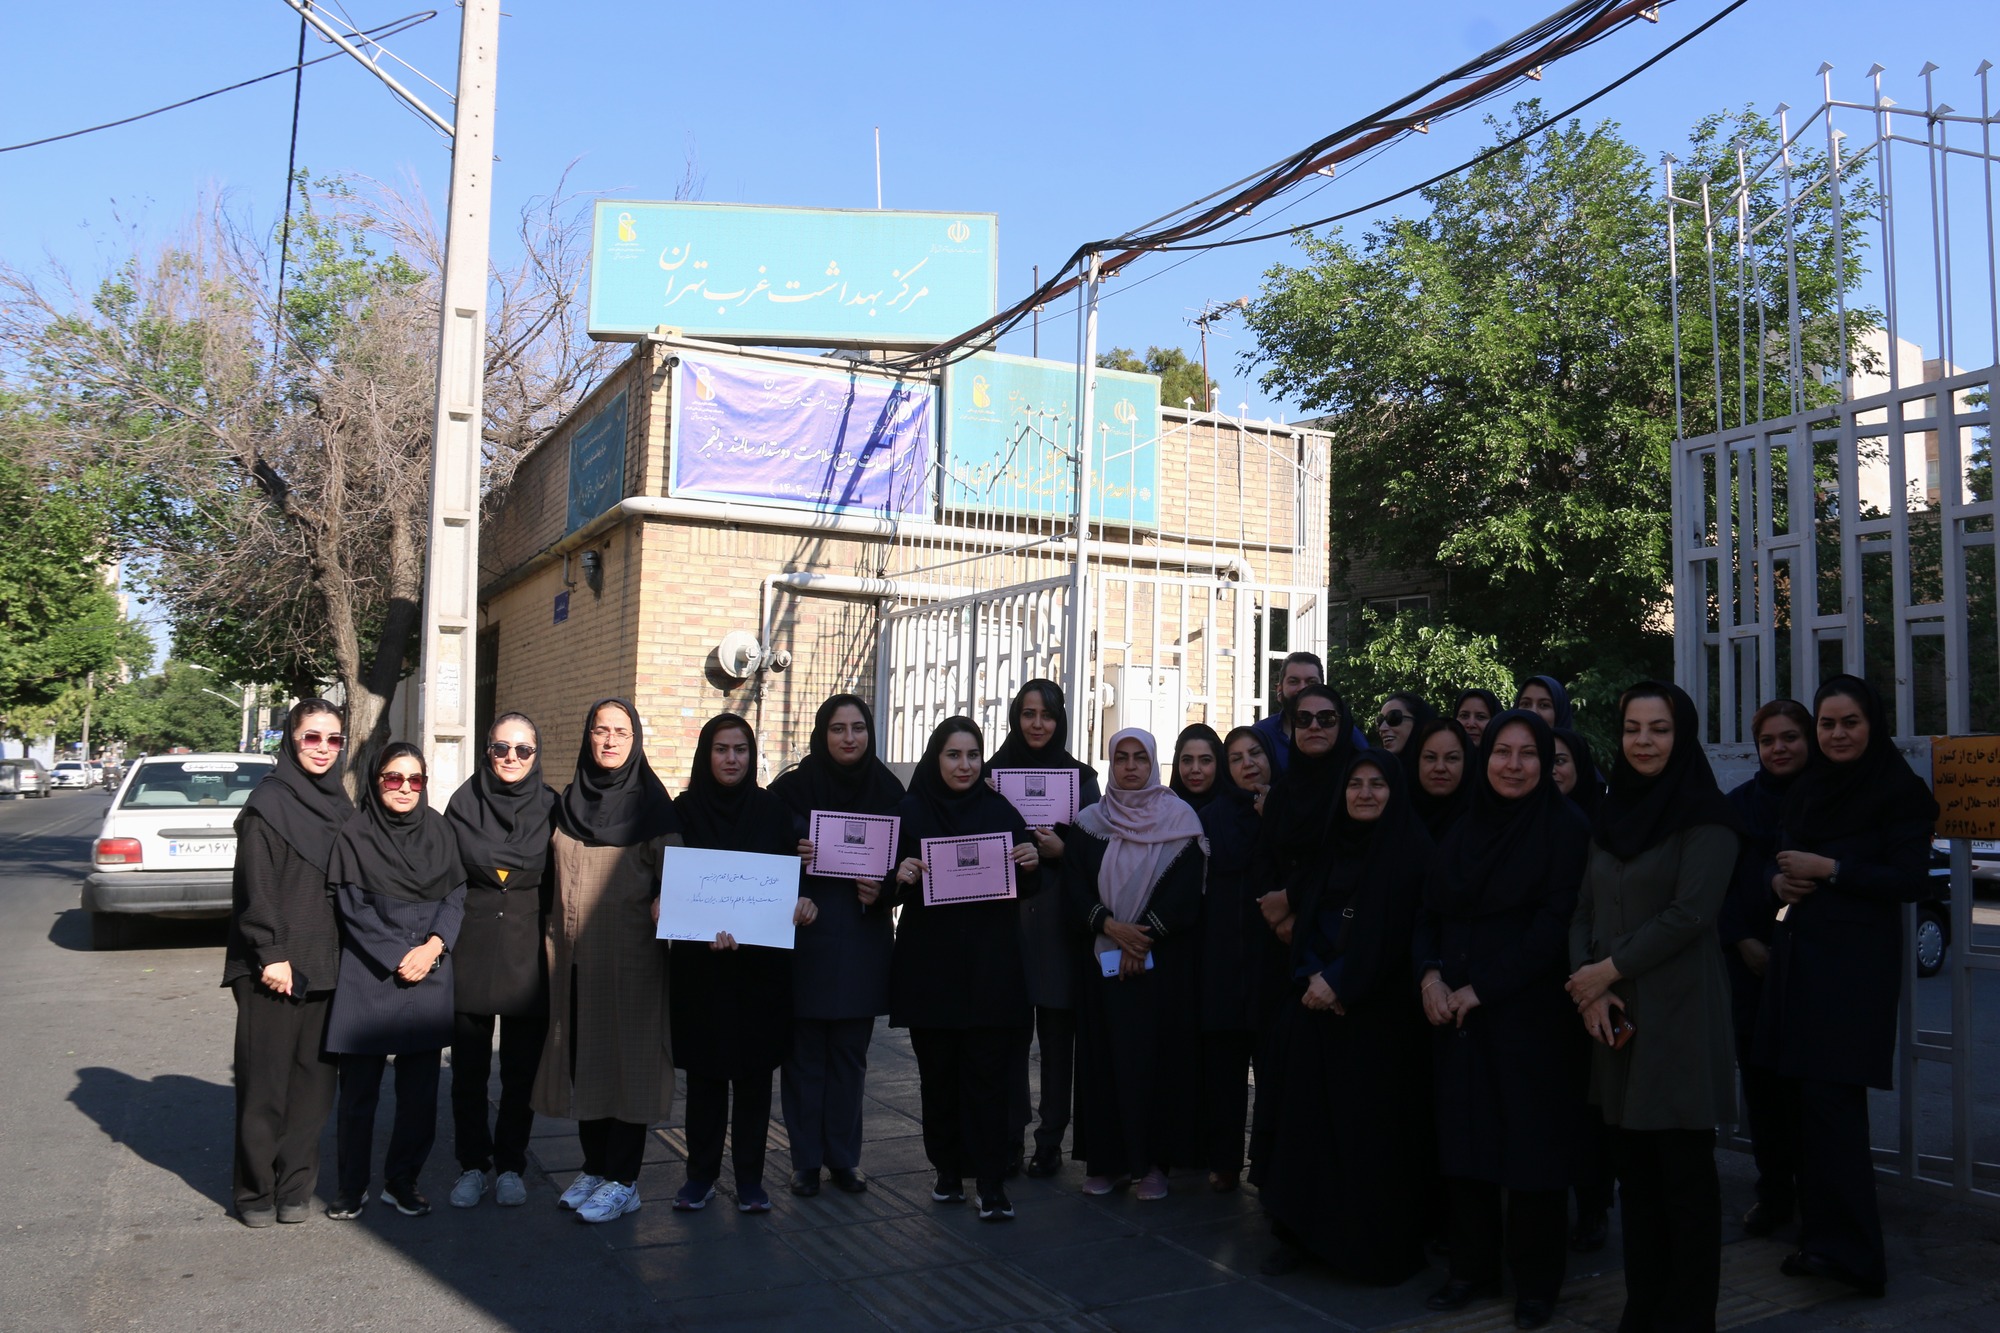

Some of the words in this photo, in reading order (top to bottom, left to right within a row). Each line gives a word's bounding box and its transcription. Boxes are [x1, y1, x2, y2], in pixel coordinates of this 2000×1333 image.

[659, 242, 709, 308] تهران
[886, 257, 930, 312] مرکز
[702, 265, 770, 315] غرب
[768, 260, 884, 317] بهداشت
[763, 378, 782, 405] تهران
[778, 390, 802, 410] غرب
[800, 390, 839, 416] بهداشت
[726, 436, 755, 454] سالمند
[756, 441, 791, 458] دوستدار
[793, 446, 835, 463] سلامت
[833, 450, 857, 475] جامع
[858, 454, 892, 471] خدمات
[893, 444, 916, 476] مرکز
[1938, 749, 1957, 765] کشور
[1958, 749, 1965, 764] از
[1966, 748, 1985, 764] خارج
[1936, 772, 1957, 785] انقلاب
[1946, 796, 1963, 811] احمر
